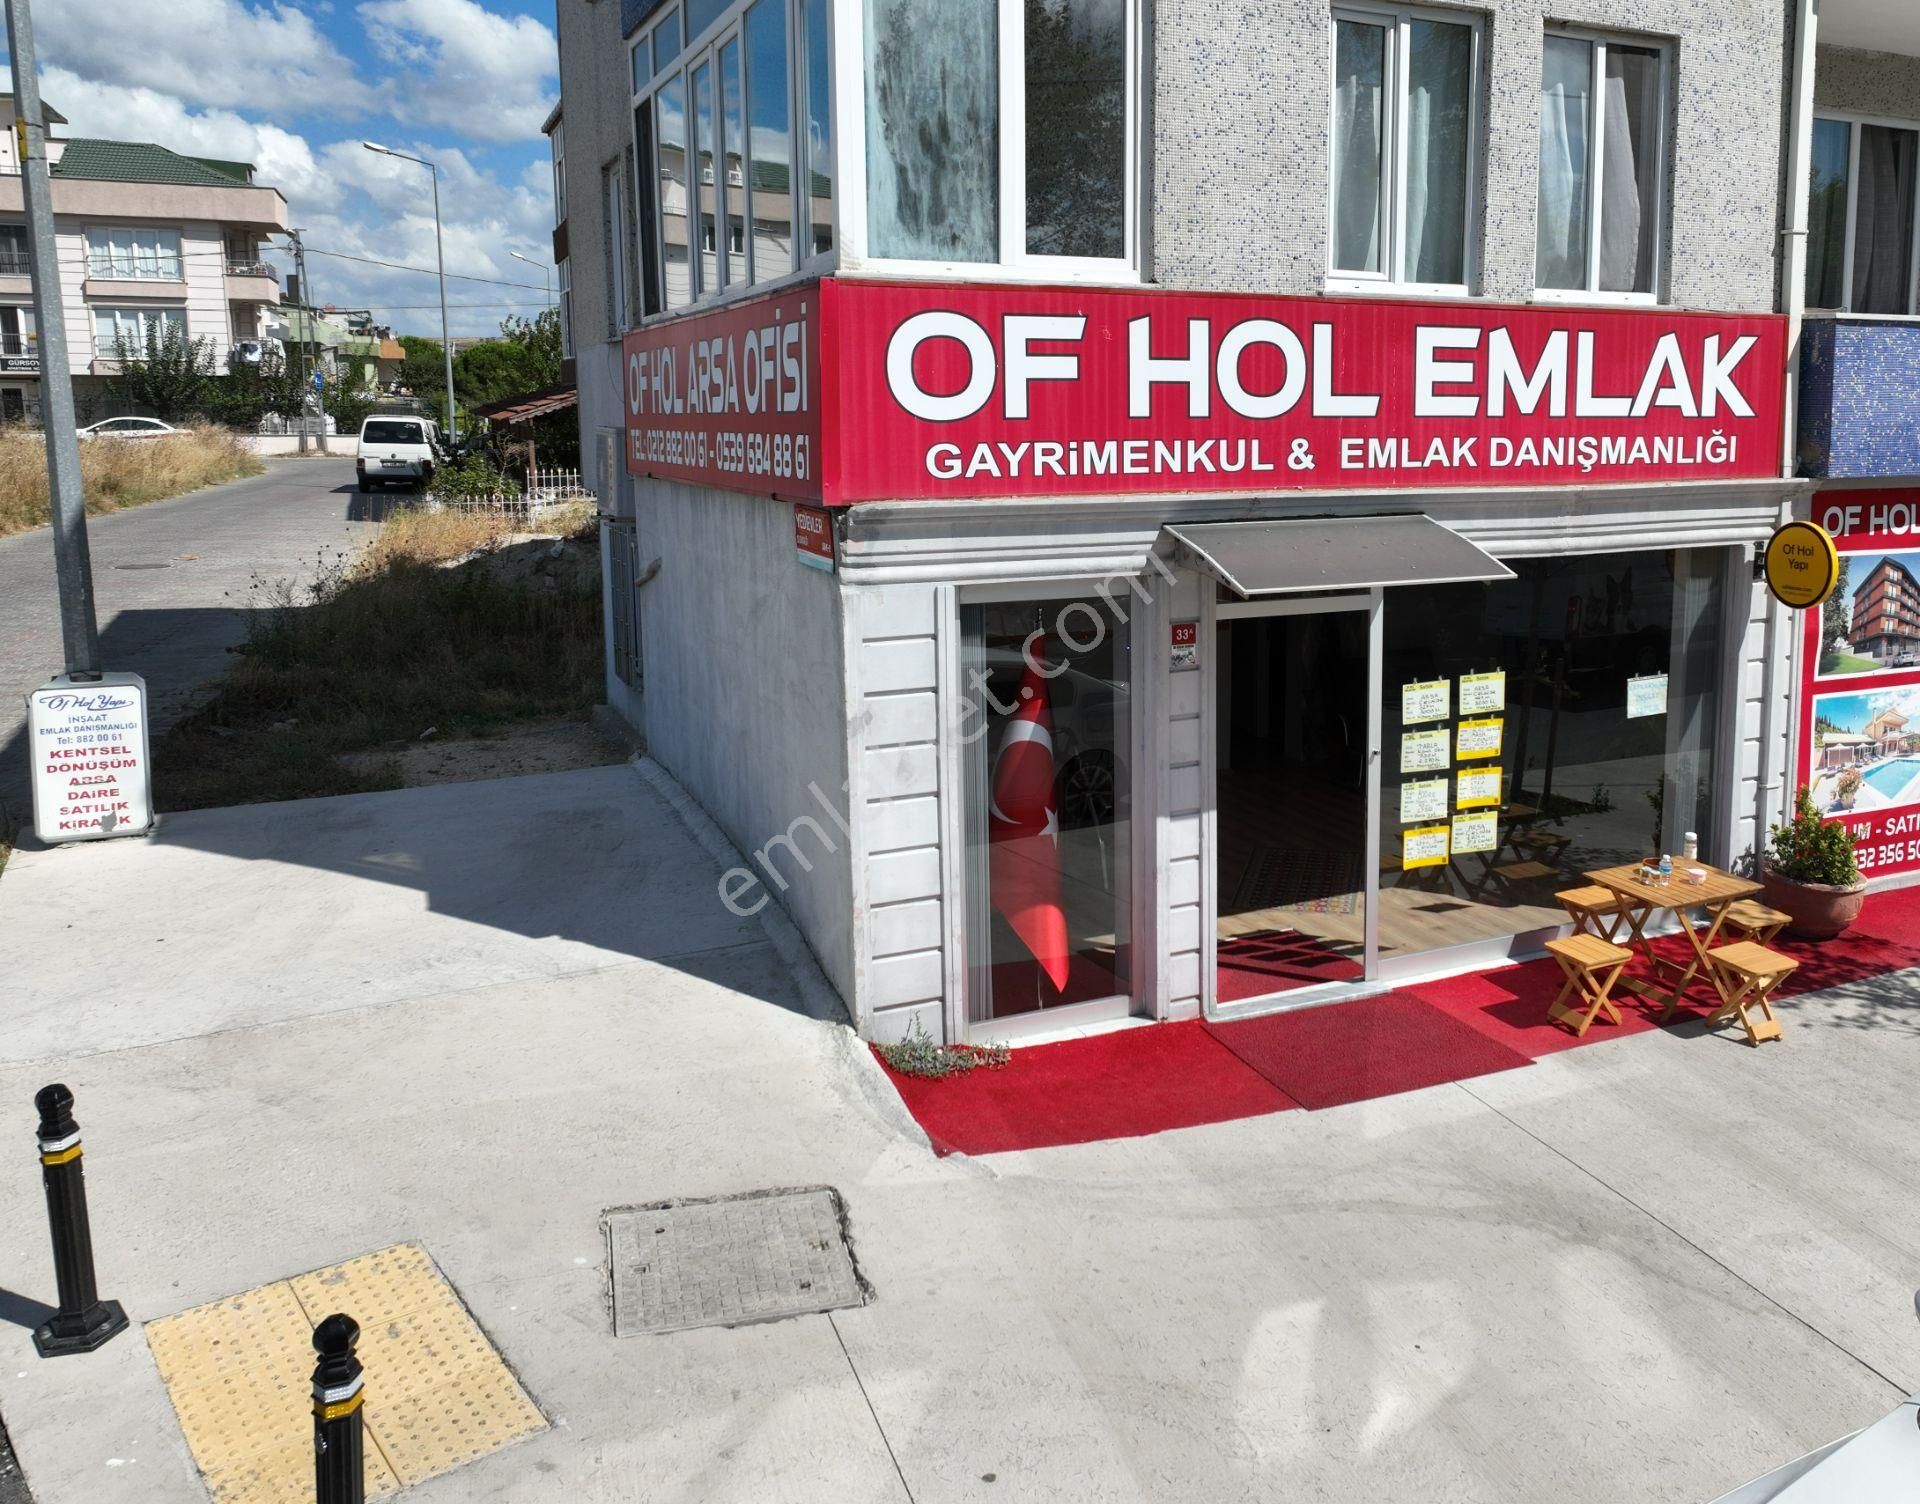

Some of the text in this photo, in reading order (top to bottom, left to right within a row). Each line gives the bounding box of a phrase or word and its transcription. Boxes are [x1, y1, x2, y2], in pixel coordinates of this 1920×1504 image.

[629, 302, 808, 415] OF HOL ARSA OFİSİ
[886, 309, 1760, 421] OF HOL EMLAK
[666, 430, 683, 464] 882
[684, 431, 696, 466] 00
[698, 431, 708, 468] 61
[716, 431, 744, 472] 0539
[747, 432, 771, 476] 684
[773, 433, 792, 478] 88
[795, 434, 810, 480] 61
[1286, 437, 1316, 471] &
[1340, 436, 1478, 469] EMLAK
[1489, 429, 1737, 473] DANIŞMANLIĞI
[1822, 503, 1920, 538] OF HOL
[1782, 543, 1815, 557] Of Hol
[40, 726, 71, 735] EMLAK
[97, 733, 109, 742] 00
[49, 746, 132, 759] KENTSEL
[46, 758, 136, 773] DÖNÜŞÜM
[59, 801, 129, 815] SATILIK
[1878, 842, 1905, 866] 356
